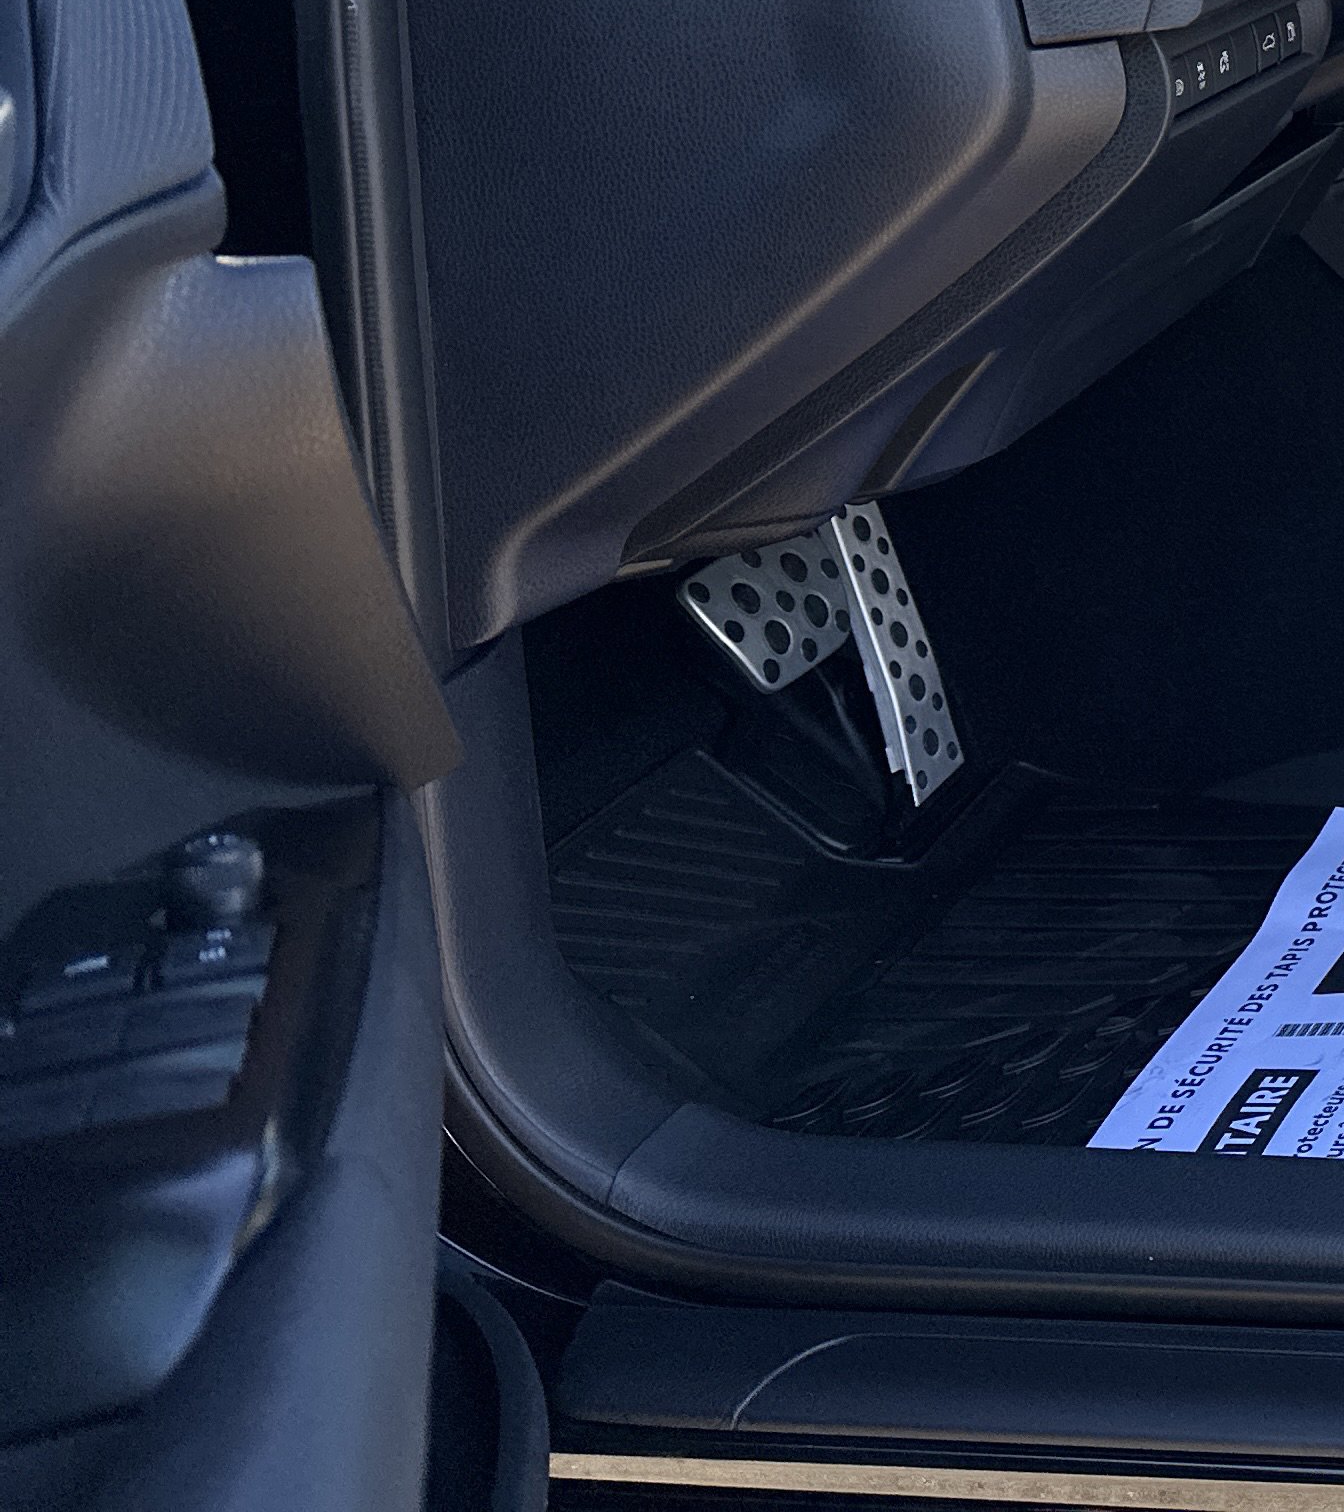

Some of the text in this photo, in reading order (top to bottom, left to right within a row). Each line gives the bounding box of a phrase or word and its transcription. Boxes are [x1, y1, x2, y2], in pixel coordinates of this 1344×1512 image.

[1146, 1104, 1185, 1128] DE
[1169, 1017, 1253, 1098] SÉCURITÉ
[1237, 982, 1278, 1012] DES
[1264, 935, 1316, 979] TAPIS
